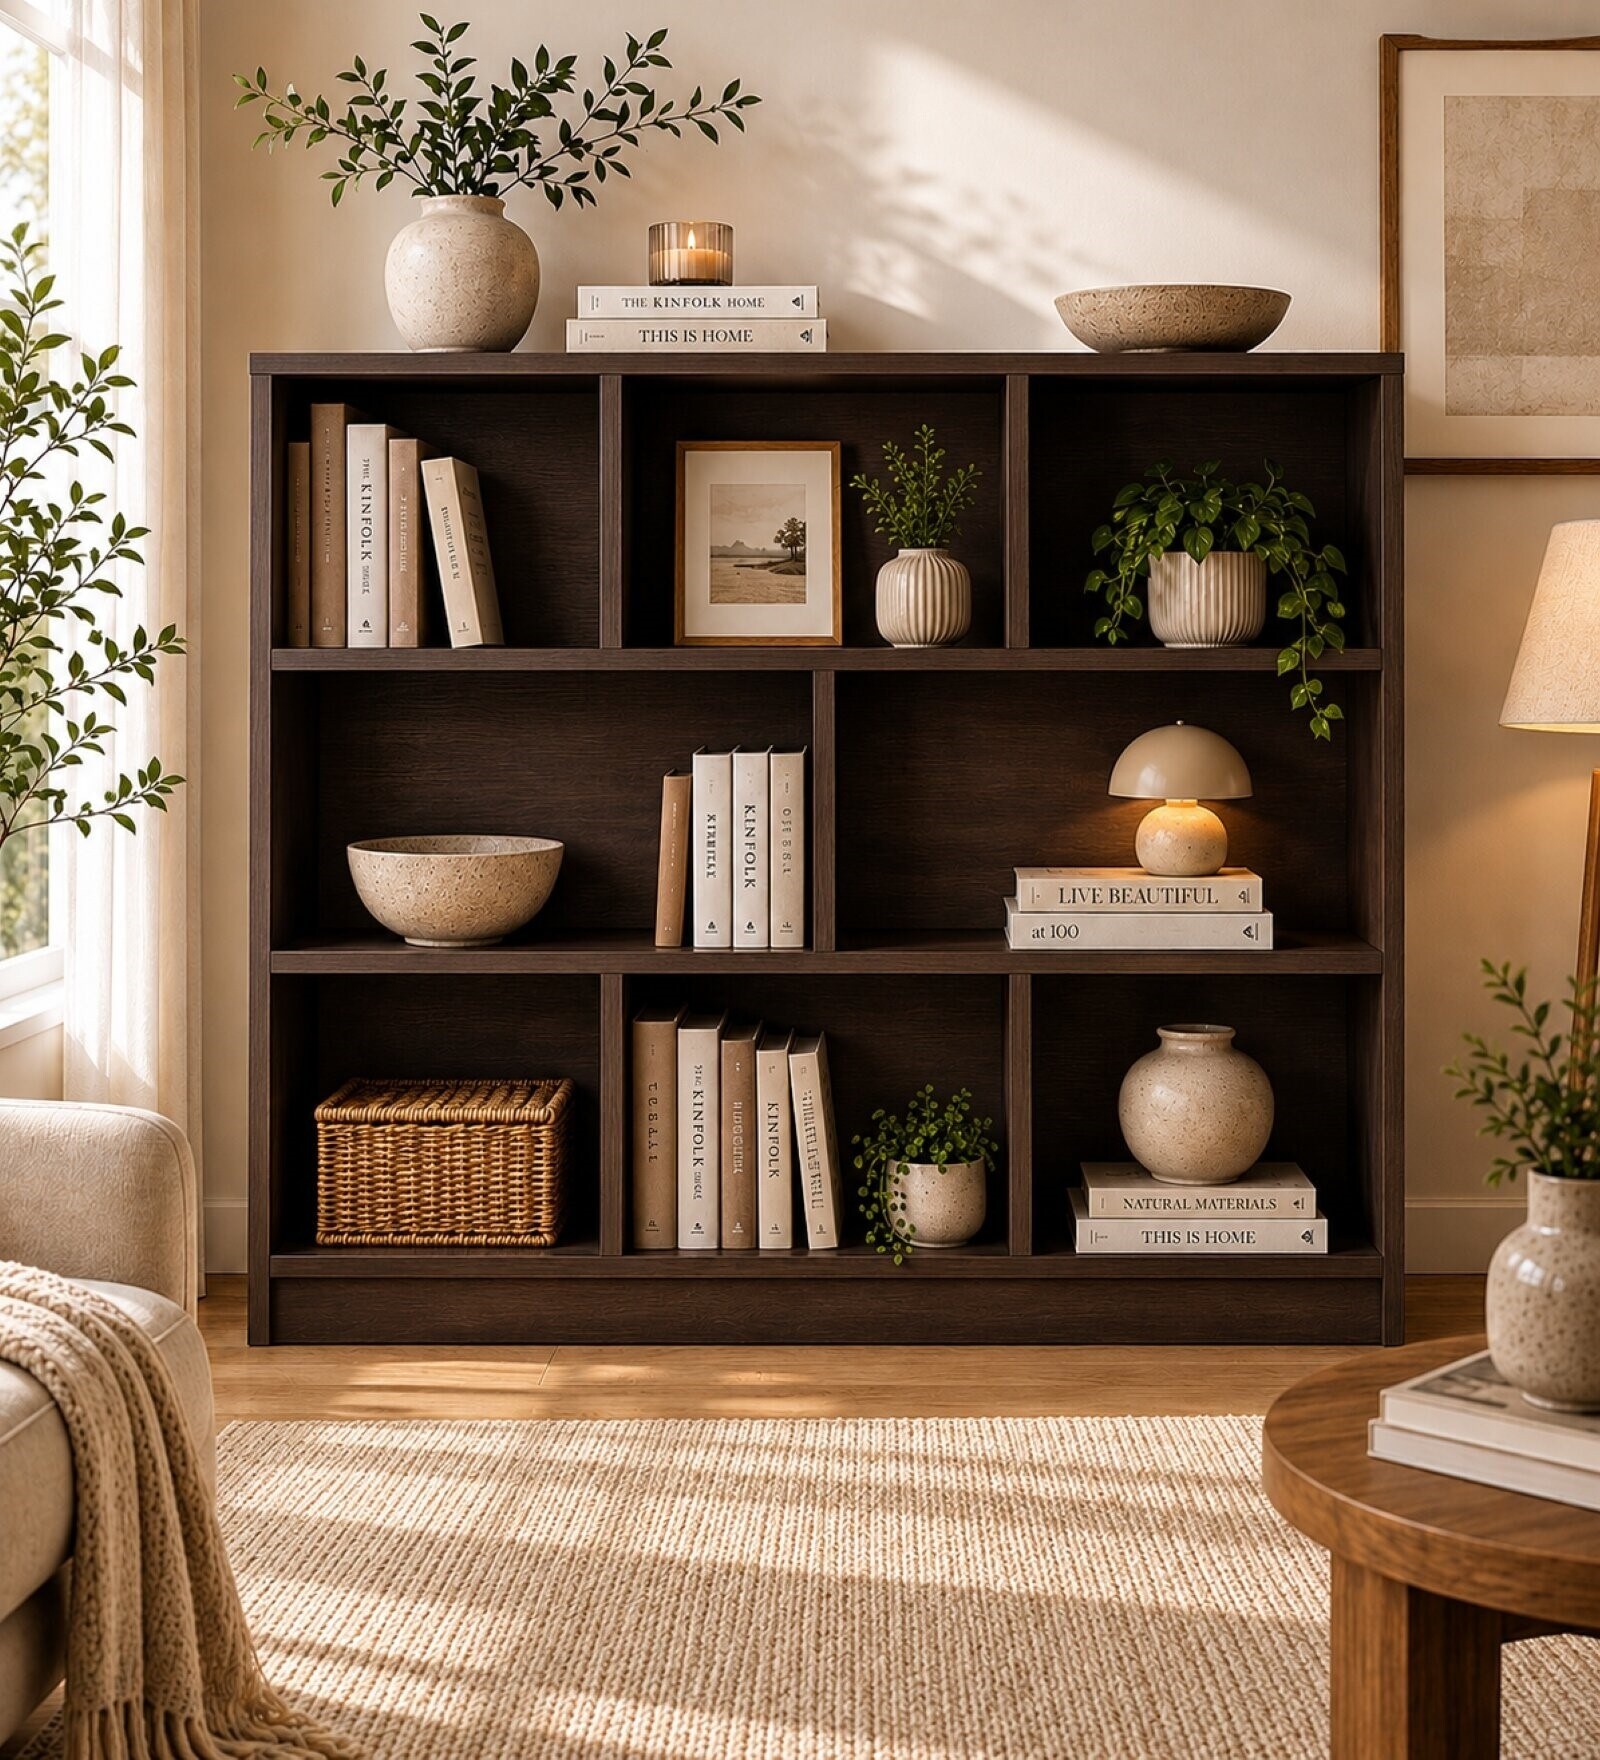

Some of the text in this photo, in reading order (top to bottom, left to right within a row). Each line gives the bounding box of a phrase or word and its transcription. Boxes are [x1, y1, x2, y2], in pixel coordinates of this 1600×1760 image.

[621, 297, 765, 308] THE KINFOLK HOME
[638, 329, 753, 343] THIS IS HOME
[361, 483, 372, 561] KINFOLK
[744, 804, 756, 889] KINFOLK
[1058, 887, 1219, 904] LIVE BEAUTIFUL
[1031, 924, 1079, 939] at 100
[692, 1090, 704, 1168] KINFOLK
[767, 1102, 780, 1179] KINFOLK
[1123, 1198, 1277, 1210] NATURAL MATERIALS
[1141, 1230, 1256, 1244] THIS IS HOME
